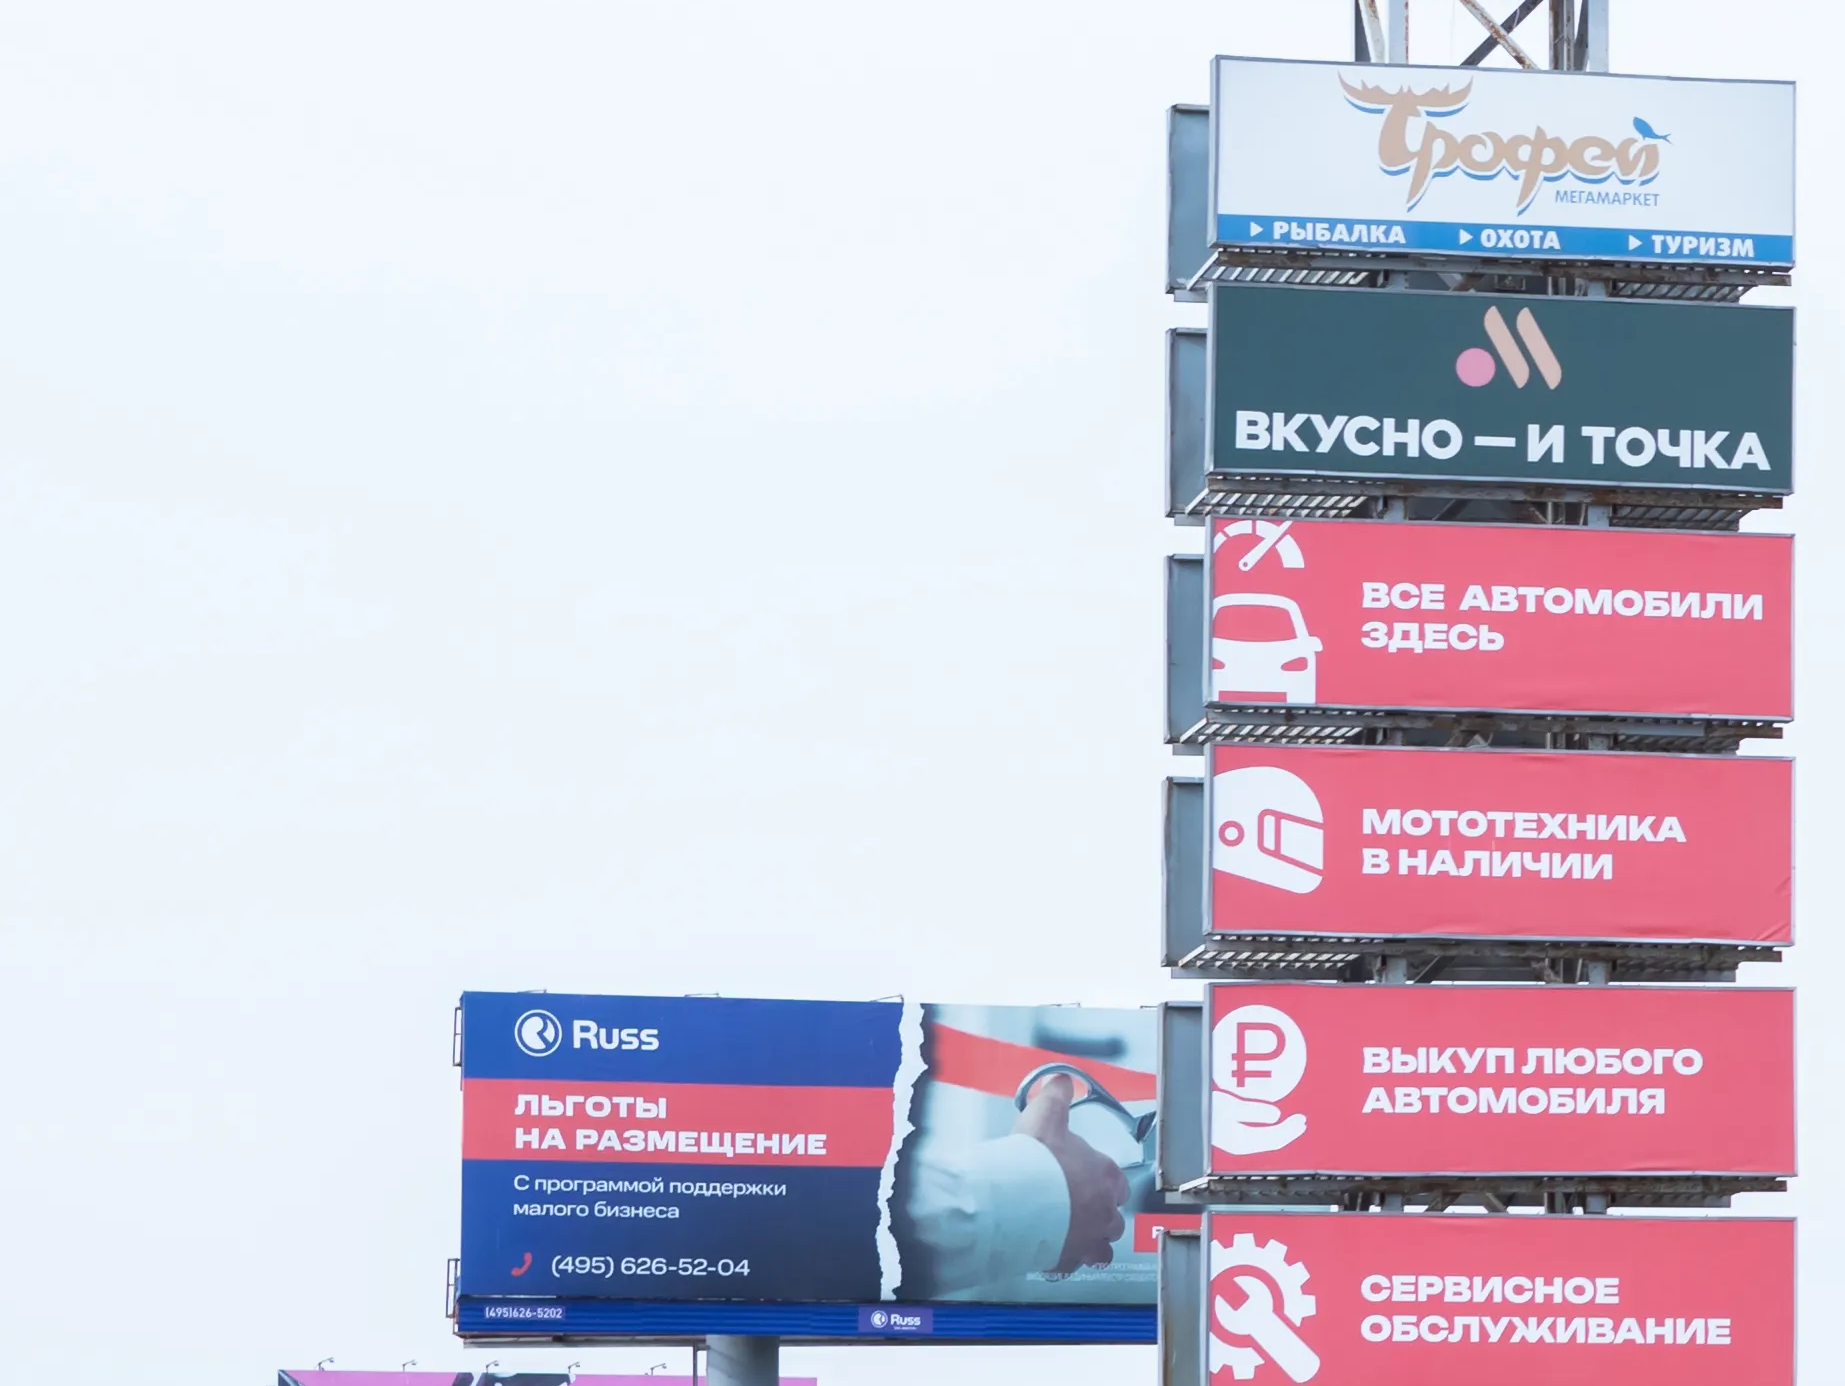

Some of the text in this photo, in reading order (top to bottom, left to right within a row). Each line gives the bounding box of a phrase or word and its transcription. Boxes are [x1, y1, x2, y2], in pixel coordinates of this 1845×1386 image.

[1338, 70, 1671, 216] Трофей
[1554, 188, 1659, 208] МЕГАМАРКЕТ
[1273, 220, 1755, 258] РЫБАЛКА ОХОТА ТУРИЗМ
[1235, 410, 1463, 459] ВКУСНО
[1526, 423, 1565, 463] И
[1581, 425, 1771, 471] ТОЧКА
[1362, 582, 1763, 620] ВСЕ АВТОМОБИЛИ
[1361, 623, 1504, 653] ЗДЕСЬ
[1361, 808, 1687, 843] МОТОТЕХНИКА
[1361, 848, 1613, 880] В НАЛИЧИИ
[572, 1020, 660, 1052] Russ
[1362, 1046, 1703, 1076] ВЫКУП ЛЮБОГО
[514, 1094, 667, 1119] ЛЬГОТЫ
[1361, 1086, 1666, 1115] АВТОМОБИЛЯ
[514, 1126, 828, 1160] НА РАЗМЕЩЕНИЕ
[513, 1175, 788, 1201] С программой поддержки
[513, 1200, 680, 1219] малого бизнеса
[550, 1255, 751, 1278] (495) 626-52-04
[1360, 1275, 1620, 1304] СЕРВИСНОЕ
[890, 1313, 921, 1326] Russ
[1360, 1315, 1731, 1345] ОБСЛУЖИВАНИЕ
